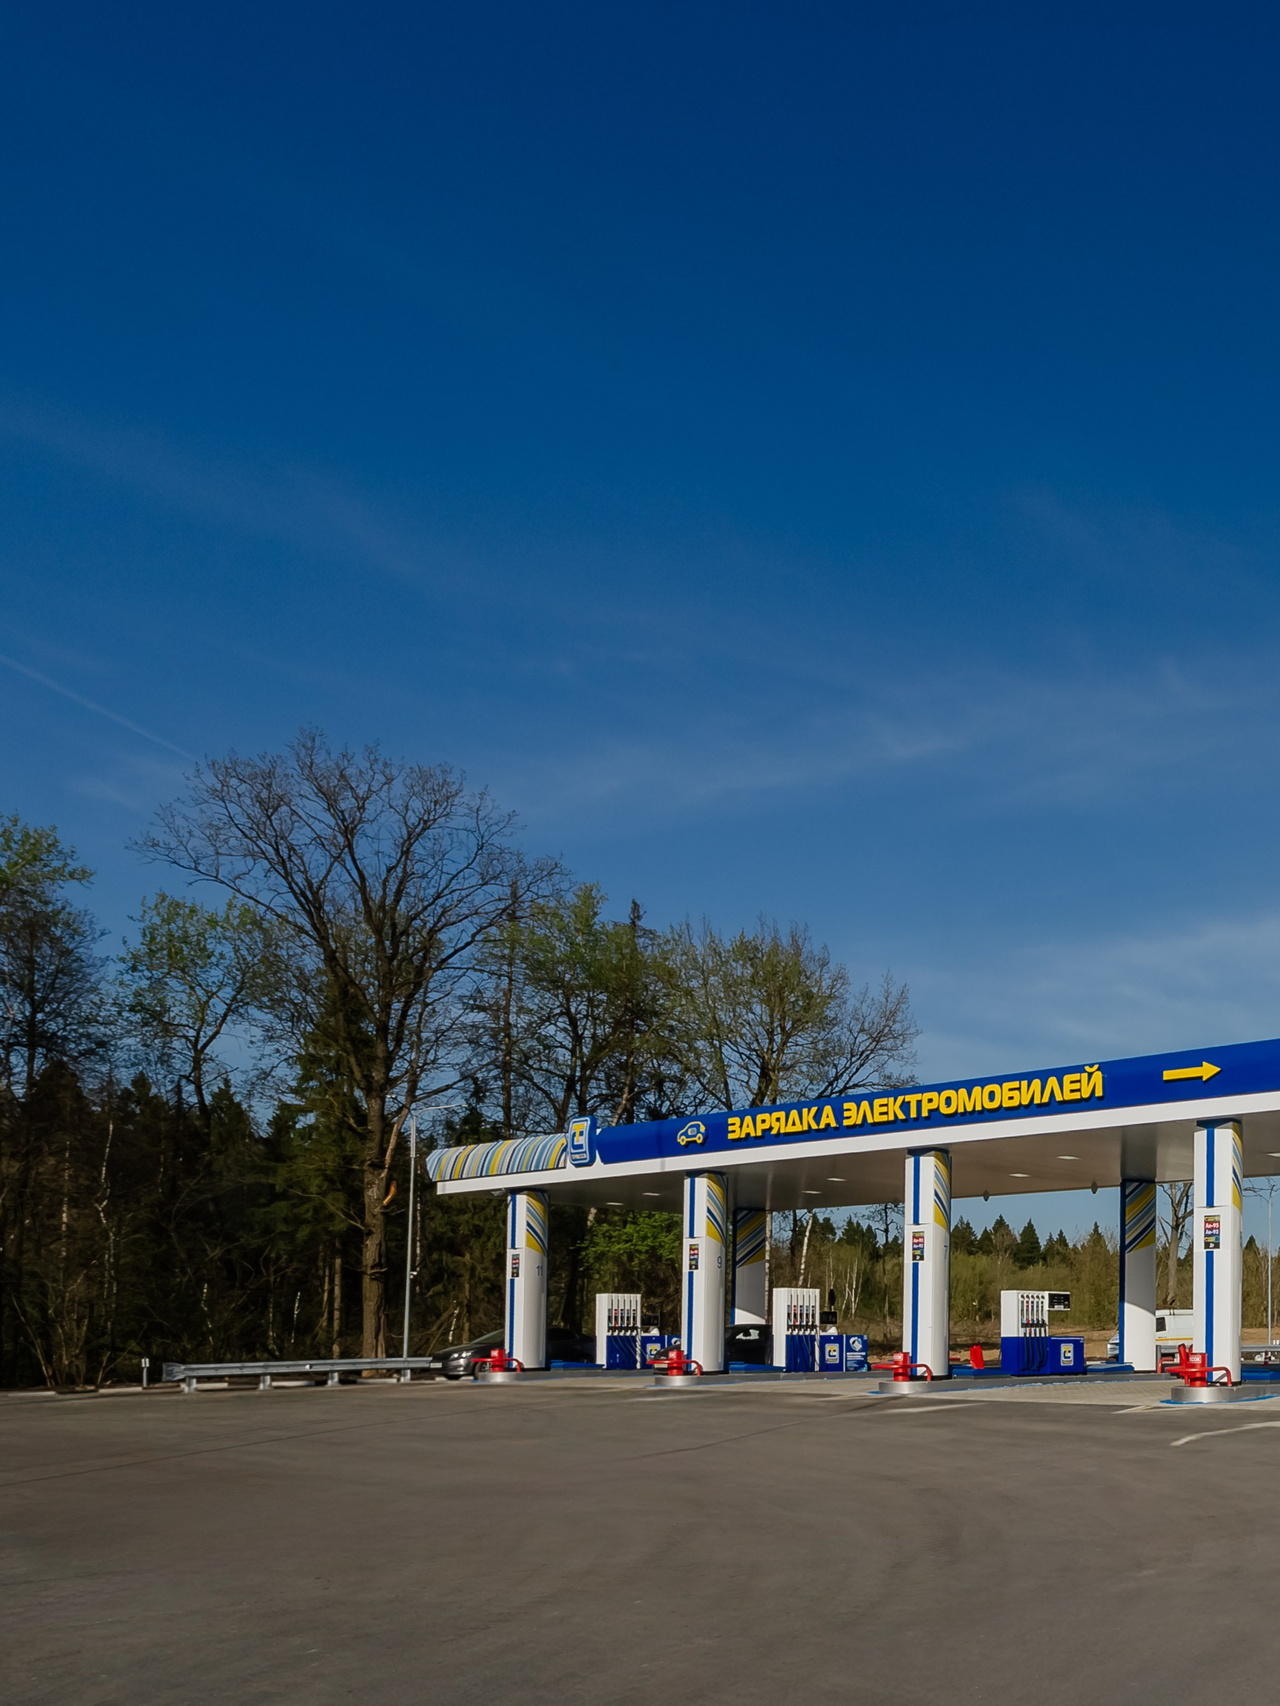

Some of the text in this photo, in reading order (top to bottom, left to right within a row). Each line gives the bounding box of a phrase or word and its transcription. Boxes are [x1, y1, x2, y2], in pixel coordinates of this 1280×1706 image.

[727, 1064, 1103, 1140] ЗАРЯДКА ЭЛЕКТРОМОБИЛЕЙ
[717, 1255, 723, 1269] 9
